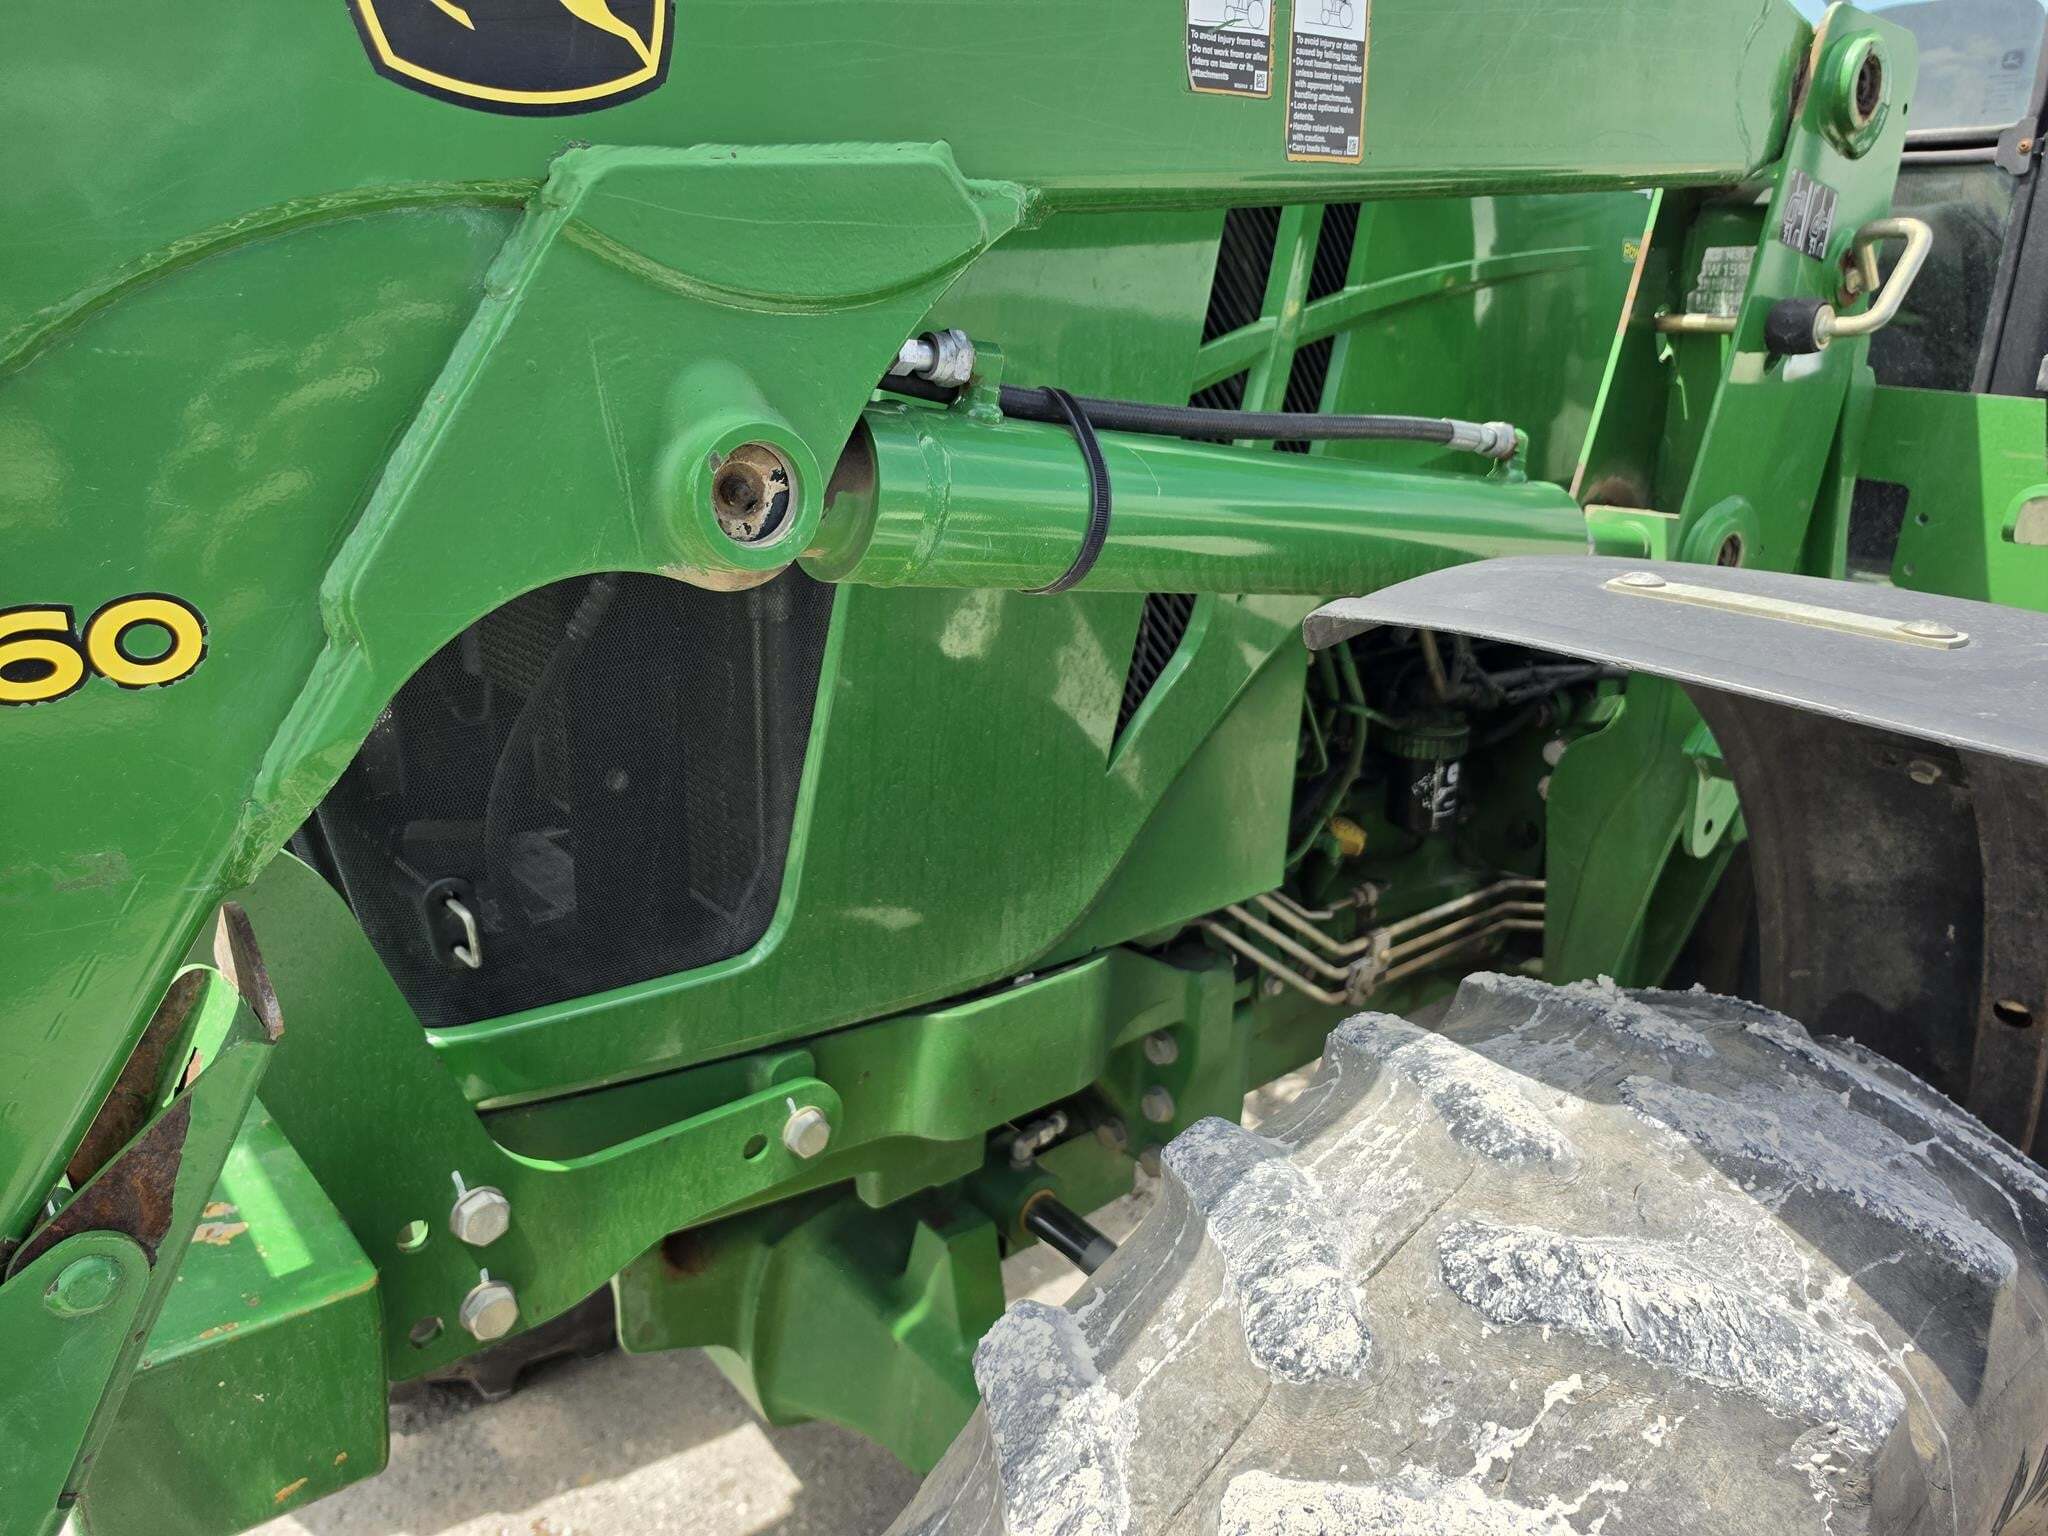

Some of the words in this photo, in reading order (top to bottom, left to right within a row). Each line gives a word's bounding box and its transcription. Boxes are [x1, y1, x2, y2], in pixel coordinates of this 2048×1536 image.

[1191, 29, 1198, 38] To
[1200, 33, 1216, 41] avoid
[1218, 34, 1235, 46] injury
[1237, 36, 1250, 45] from
[1297, 35, 1303, 44] To
[1304, 37, 1319, 46] avoid
[1320, 38, 1335, 49] injury
[1343, 42, 1357, 51] death
[1192, 44, 1201, 52] Do
[1230, 50, 1244, 58] from
[1253, 52, 1268, 61] allow
[1296, 48, 1315, 56] caused
[1316, 49, 1323, 59] by
[1192, 57, 1209, 66] riders
[1220, 60, 1237, 69] loader
[1296, 57, 1303, 65] Do
[1294, 101, 1307, 109] Lock
[1318, 104, 1339, 112] optional
[1293, 122, 1311, 131] Handle
[1312, 124, 1329, 133] raised
[1330, 125, 1344, 134] loads
[1292, 143, 1306, 152] Carry
[1306, 144, 1320, 152] loads
